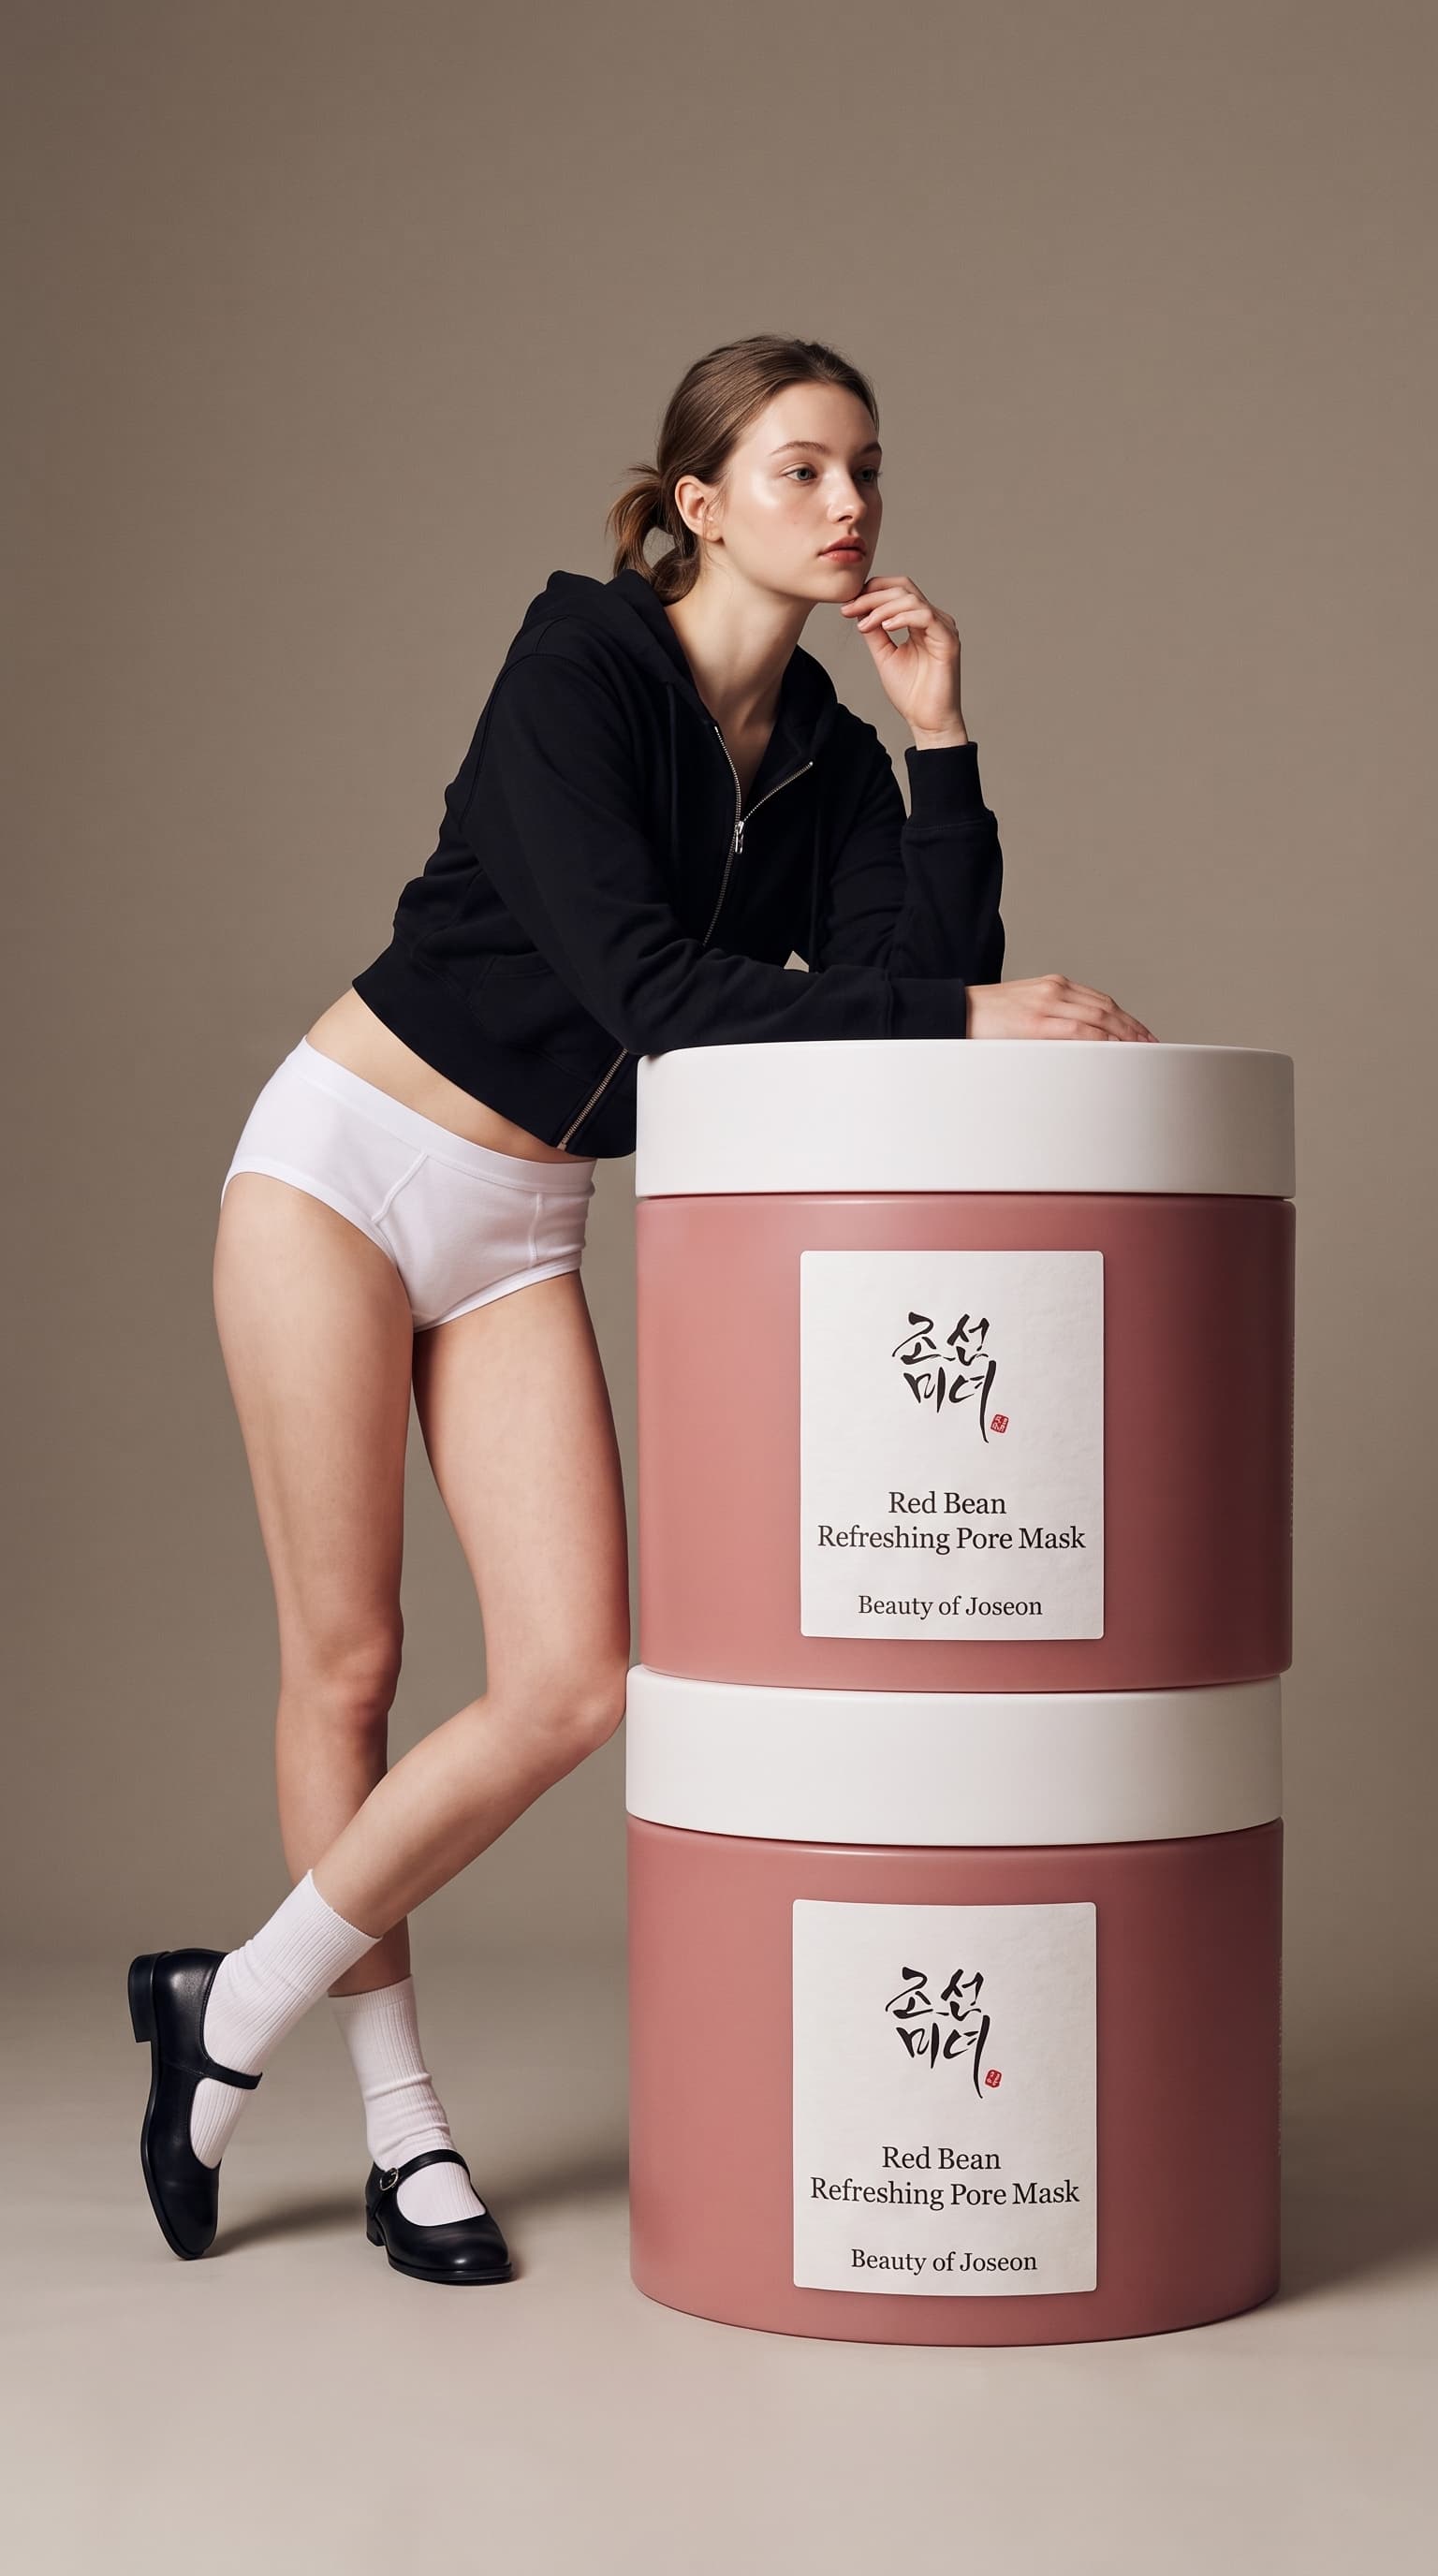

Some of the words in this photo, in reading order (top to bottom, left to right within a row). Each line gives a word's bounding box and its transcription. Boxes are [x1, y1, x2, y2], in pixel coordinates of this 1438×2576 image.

[892, 1311, 990, 1367] 조선
[903, 1360, 997, 1443] 미녀
[888, 1491, 937, 1515] Red
[944, 1492, 1006, 1515] Bean
[817, 1525, 950, 1556] Refreshing
[956, 1528, 1013, 1549] Pore
[1018, 1526, 1086, 1550] Mask
[858, 1595, 933, 1621] Beauty
[938, 1596, 961, 1616] of
[965, 1597, 1043, 1617] Joseon
[886, 1967, 985, 2022] 조선
[896, 2015, 990, 2100] 미녀
[882, 2146, 932, 2170] Red
[937, 2148, 1002, 2171] Bean
[810, 2177, 944, 2212] Refreshing
[950, 2184, 1007, 2206] Pore
[1012, 2179, 1080, 2205] Mask
[850, 2249, 927, 2276] Beauty
[932, 2251, 957, 2272] of
[960, 2251, 1038, 2273] Joseon
